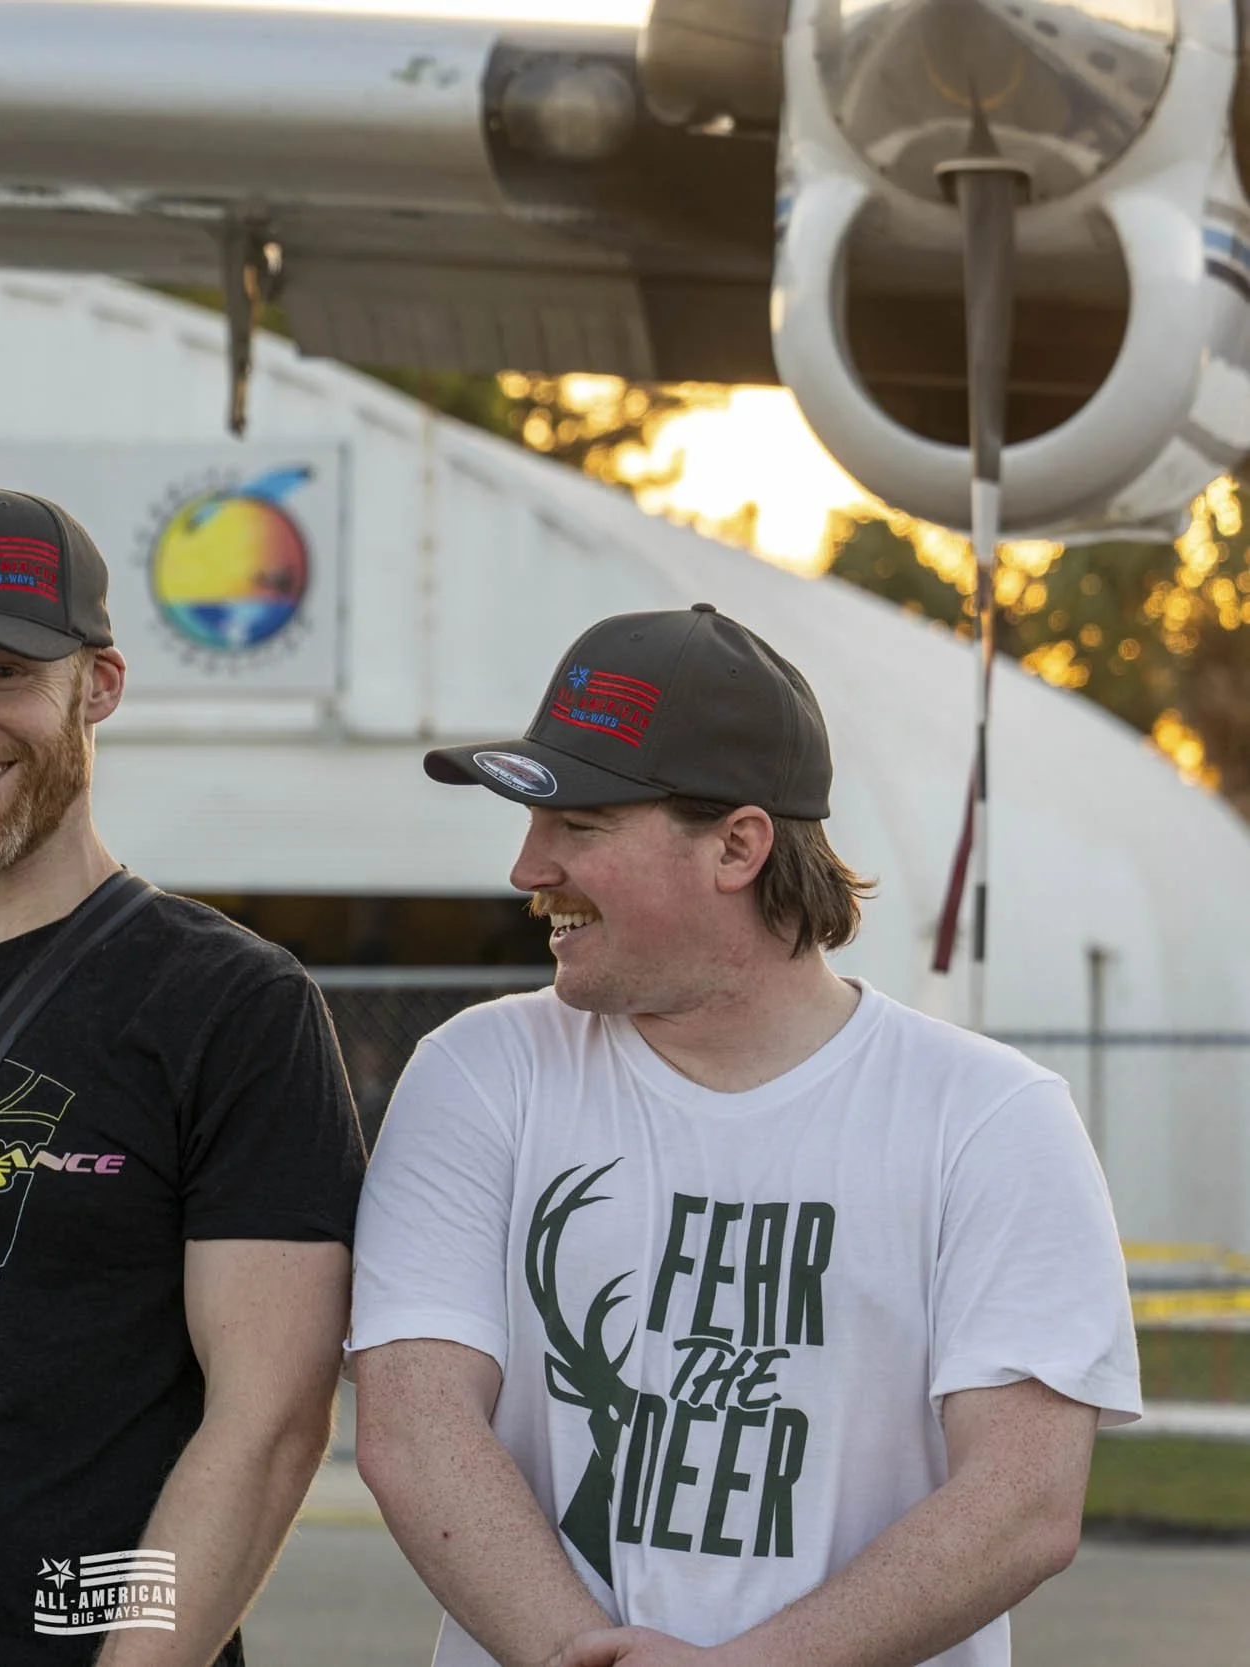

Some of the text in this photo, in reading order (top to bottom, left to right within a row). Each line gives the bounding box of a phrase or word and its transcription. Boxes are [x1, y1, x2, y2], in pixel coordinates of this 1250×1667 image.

[647, 1192, 836, 1346] FEAR
[669, 1336, 791, 1411] THE
[616, 1393, 809, 1557] DEER
